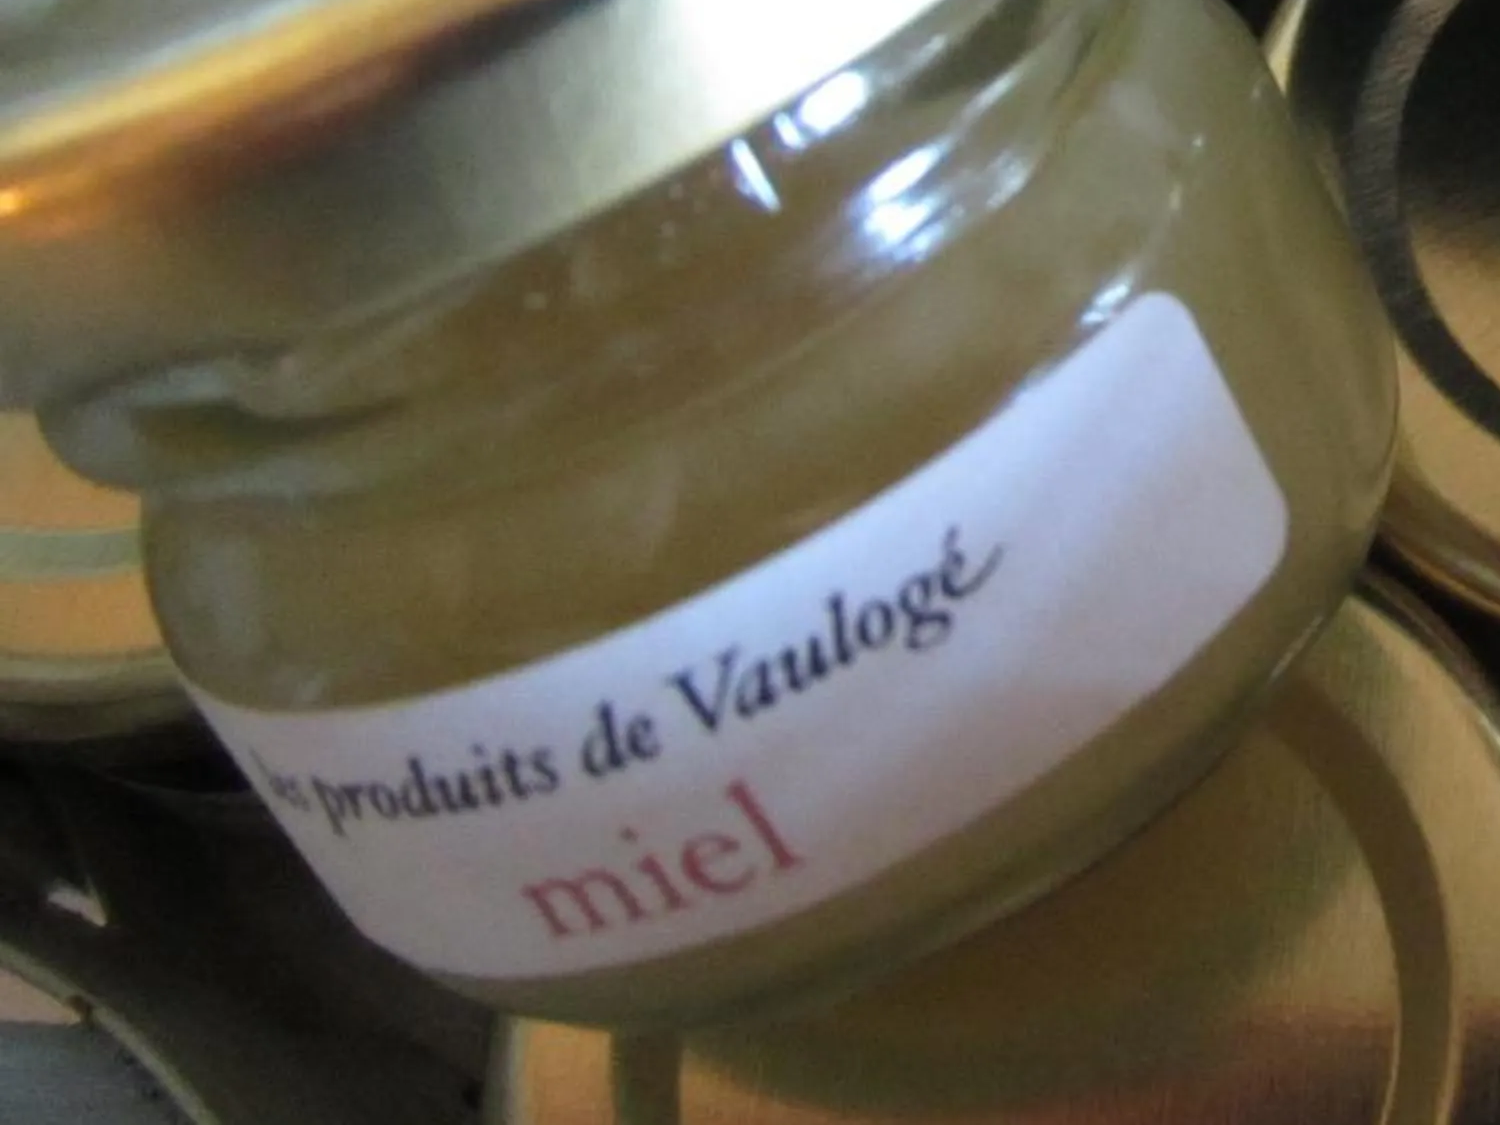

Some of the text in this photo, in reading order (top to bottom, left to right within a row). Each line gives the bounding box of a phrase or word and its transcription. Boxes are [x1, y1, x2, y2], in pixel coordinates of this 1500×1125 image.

[309, 743, 562, 838] produits
[580, 699, 662, 779] de
[665, 524, 1006, 735] Vaulogé
[520, 778, 805, 938] miel
